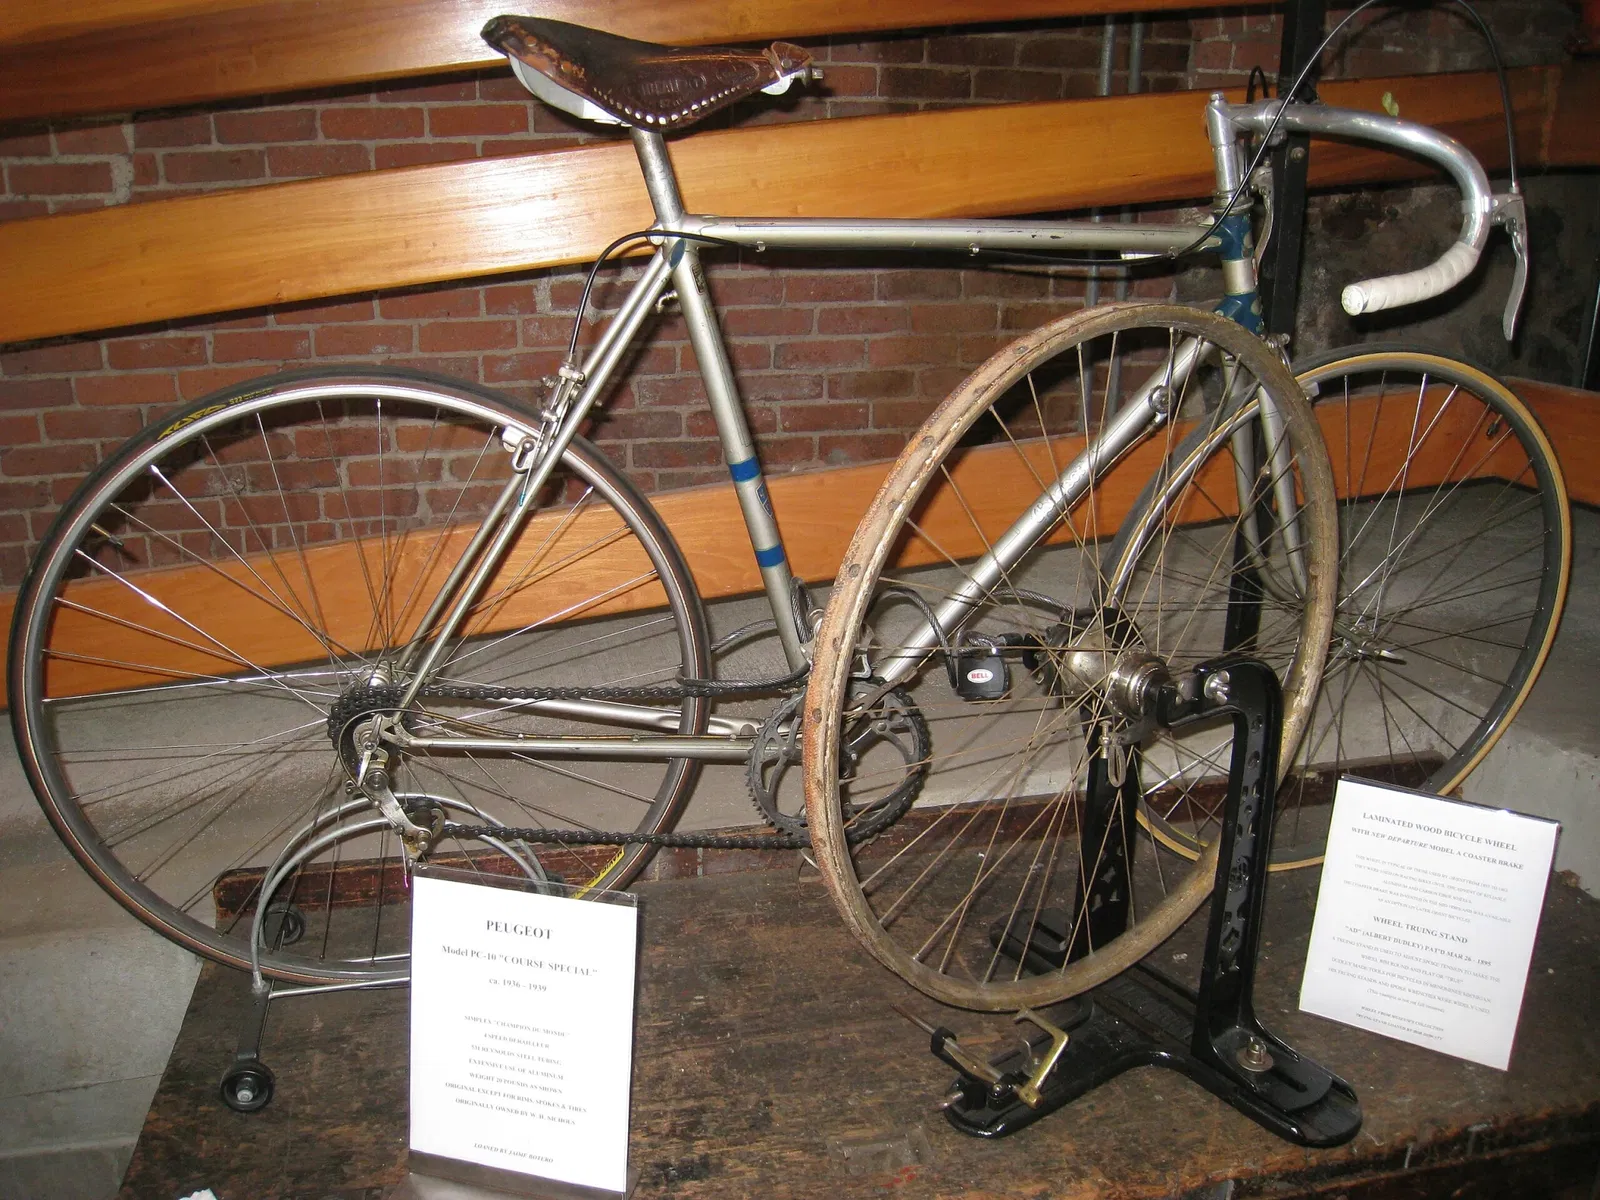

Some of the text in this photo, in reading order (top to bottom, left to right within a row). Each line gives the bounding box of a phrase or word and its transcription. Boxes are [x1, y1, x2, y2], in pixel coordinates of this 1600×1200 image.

[1362, 812, 1517, 852] LAMINATED WOOD BICYCLE WHEEL
[1352, 826, 1369, 836] WITH
[1371, 831, 1387, 840] NEW
[1388, 835, 1428, 849] DEPARTURE
[1429, 844, 1454, 855] MODEL
[1463, 851, 1497, 865] COASTER
[1498, 859, 1524, 870] BRAKE
[486, 920, 554, 940] PEUGEOT
[1372, 915, 1468, 944] WHEEL TRUING STAND
[441, 945, 598, 976] Model PC-10 "COURSE SPECIAL"
[1362, 930, 1392, 943] (ALBERT
[1393, 937, 1424, 950] DUDLEY)
[1425, 944, 1446, 956] PAT'D
[1447, 950, 1463, 960] MAR
[1477, 958, 1492, 967] 1895
[489, 978, 500, 986] ca.
[503, 978, 521, 988] 1936
[528, 983, 547, 993] 1939
